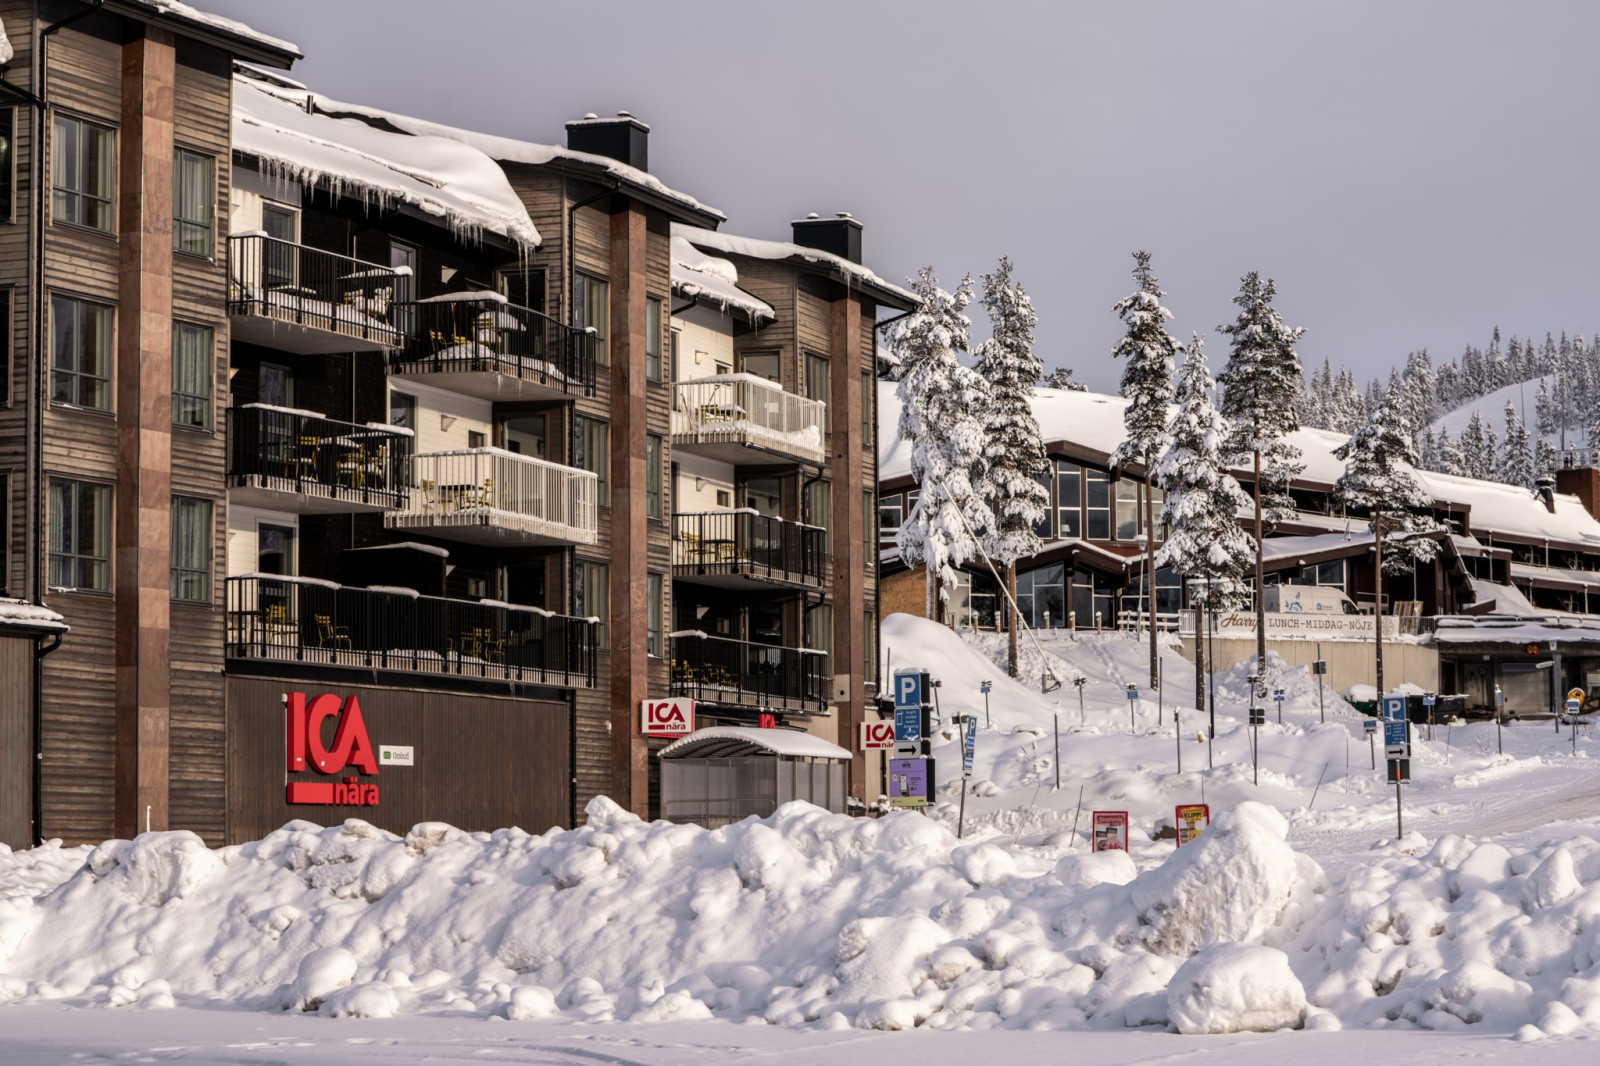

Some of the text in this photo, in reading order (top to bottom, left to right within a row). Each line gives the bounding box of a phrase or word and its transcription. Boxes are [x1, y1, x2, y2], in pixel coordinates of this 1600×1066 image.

[1269, 618, 1373, 631] LUNCH-MIDDAG-NÖJE
[901, 677, 916, 704] P
[648, 703, 686, 723] ICA
[1388, 699, 1402, 720] P
[666, 722, 686, 730] nära
[759, 713, 776, 729] ICA
[969, 718, 976, 736] P
[287, 692, 379, 775] ICA
[866, 724, 895, 742] ICA
[333, 776, 379, 805] nära
